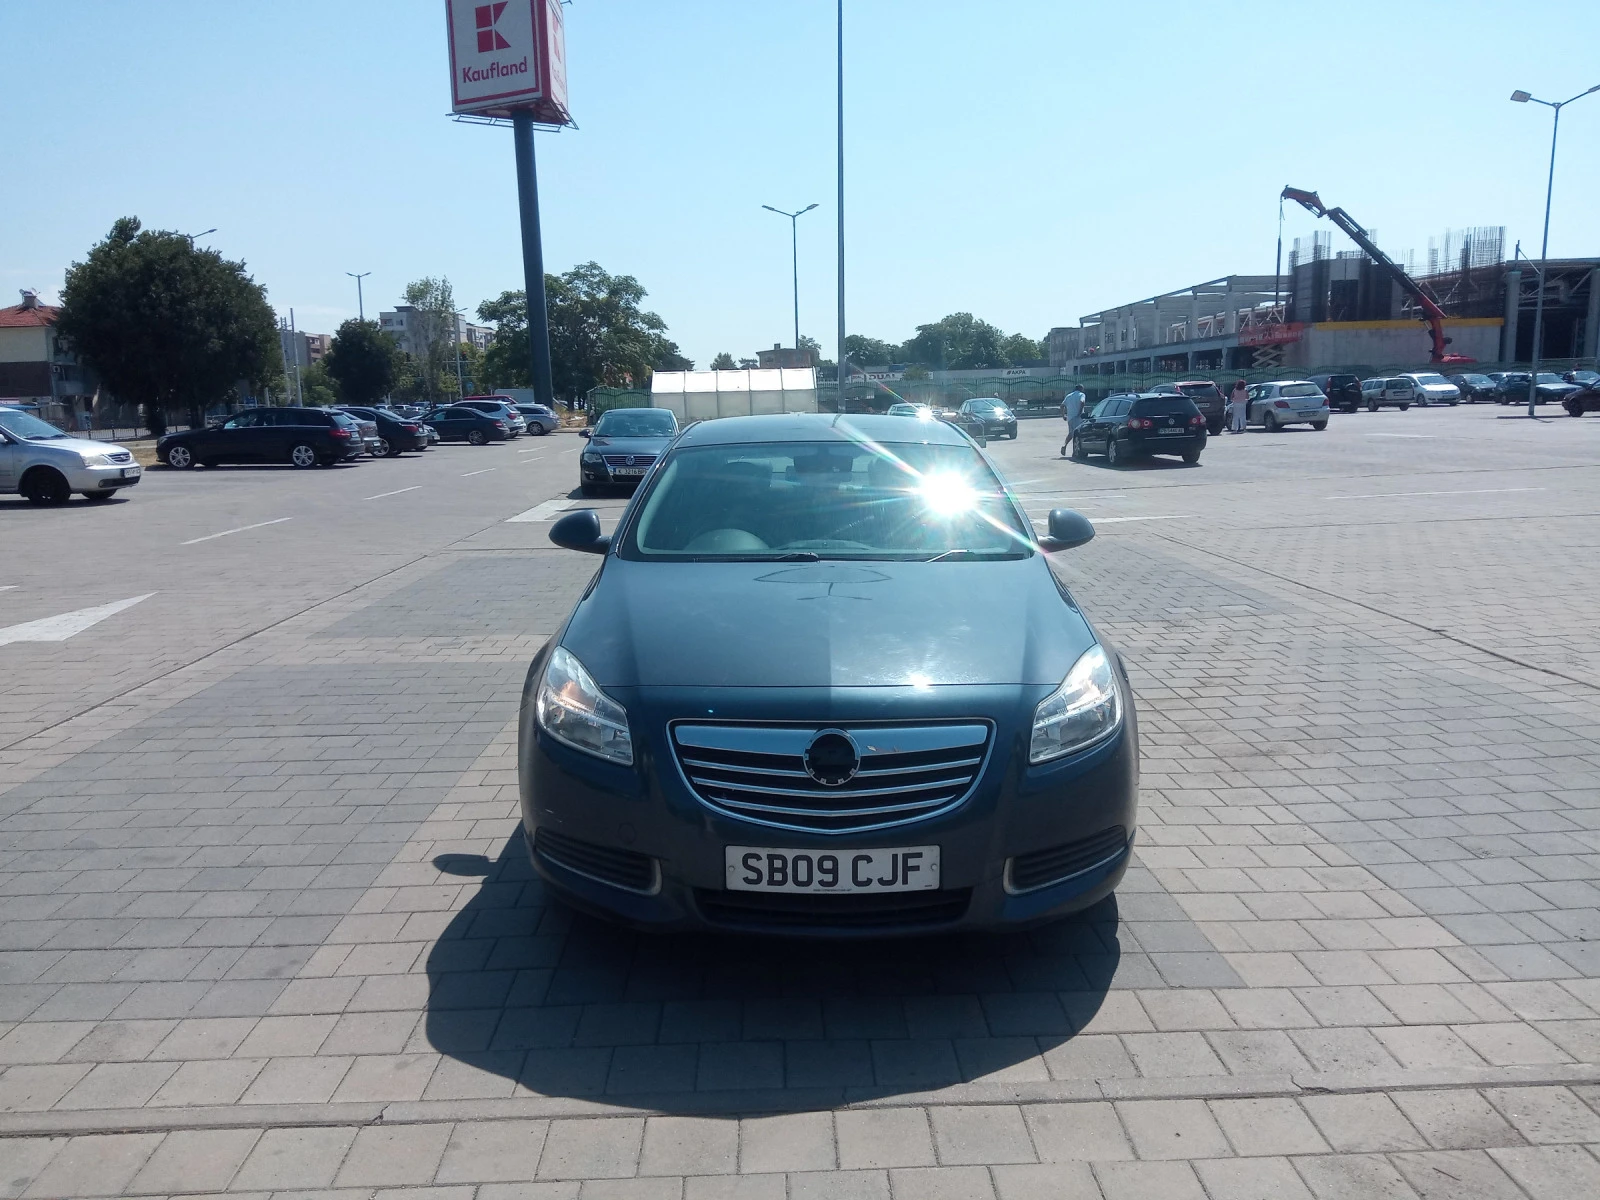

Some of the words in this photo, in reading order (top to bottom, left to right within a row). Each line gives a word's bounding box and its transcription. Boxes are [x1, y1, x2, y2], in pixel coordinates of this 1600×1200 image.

[462, 56, 528, 83] Kaufland
[742, 852, 839, 888] SB09
[851, 851, 924, 887] CJF
